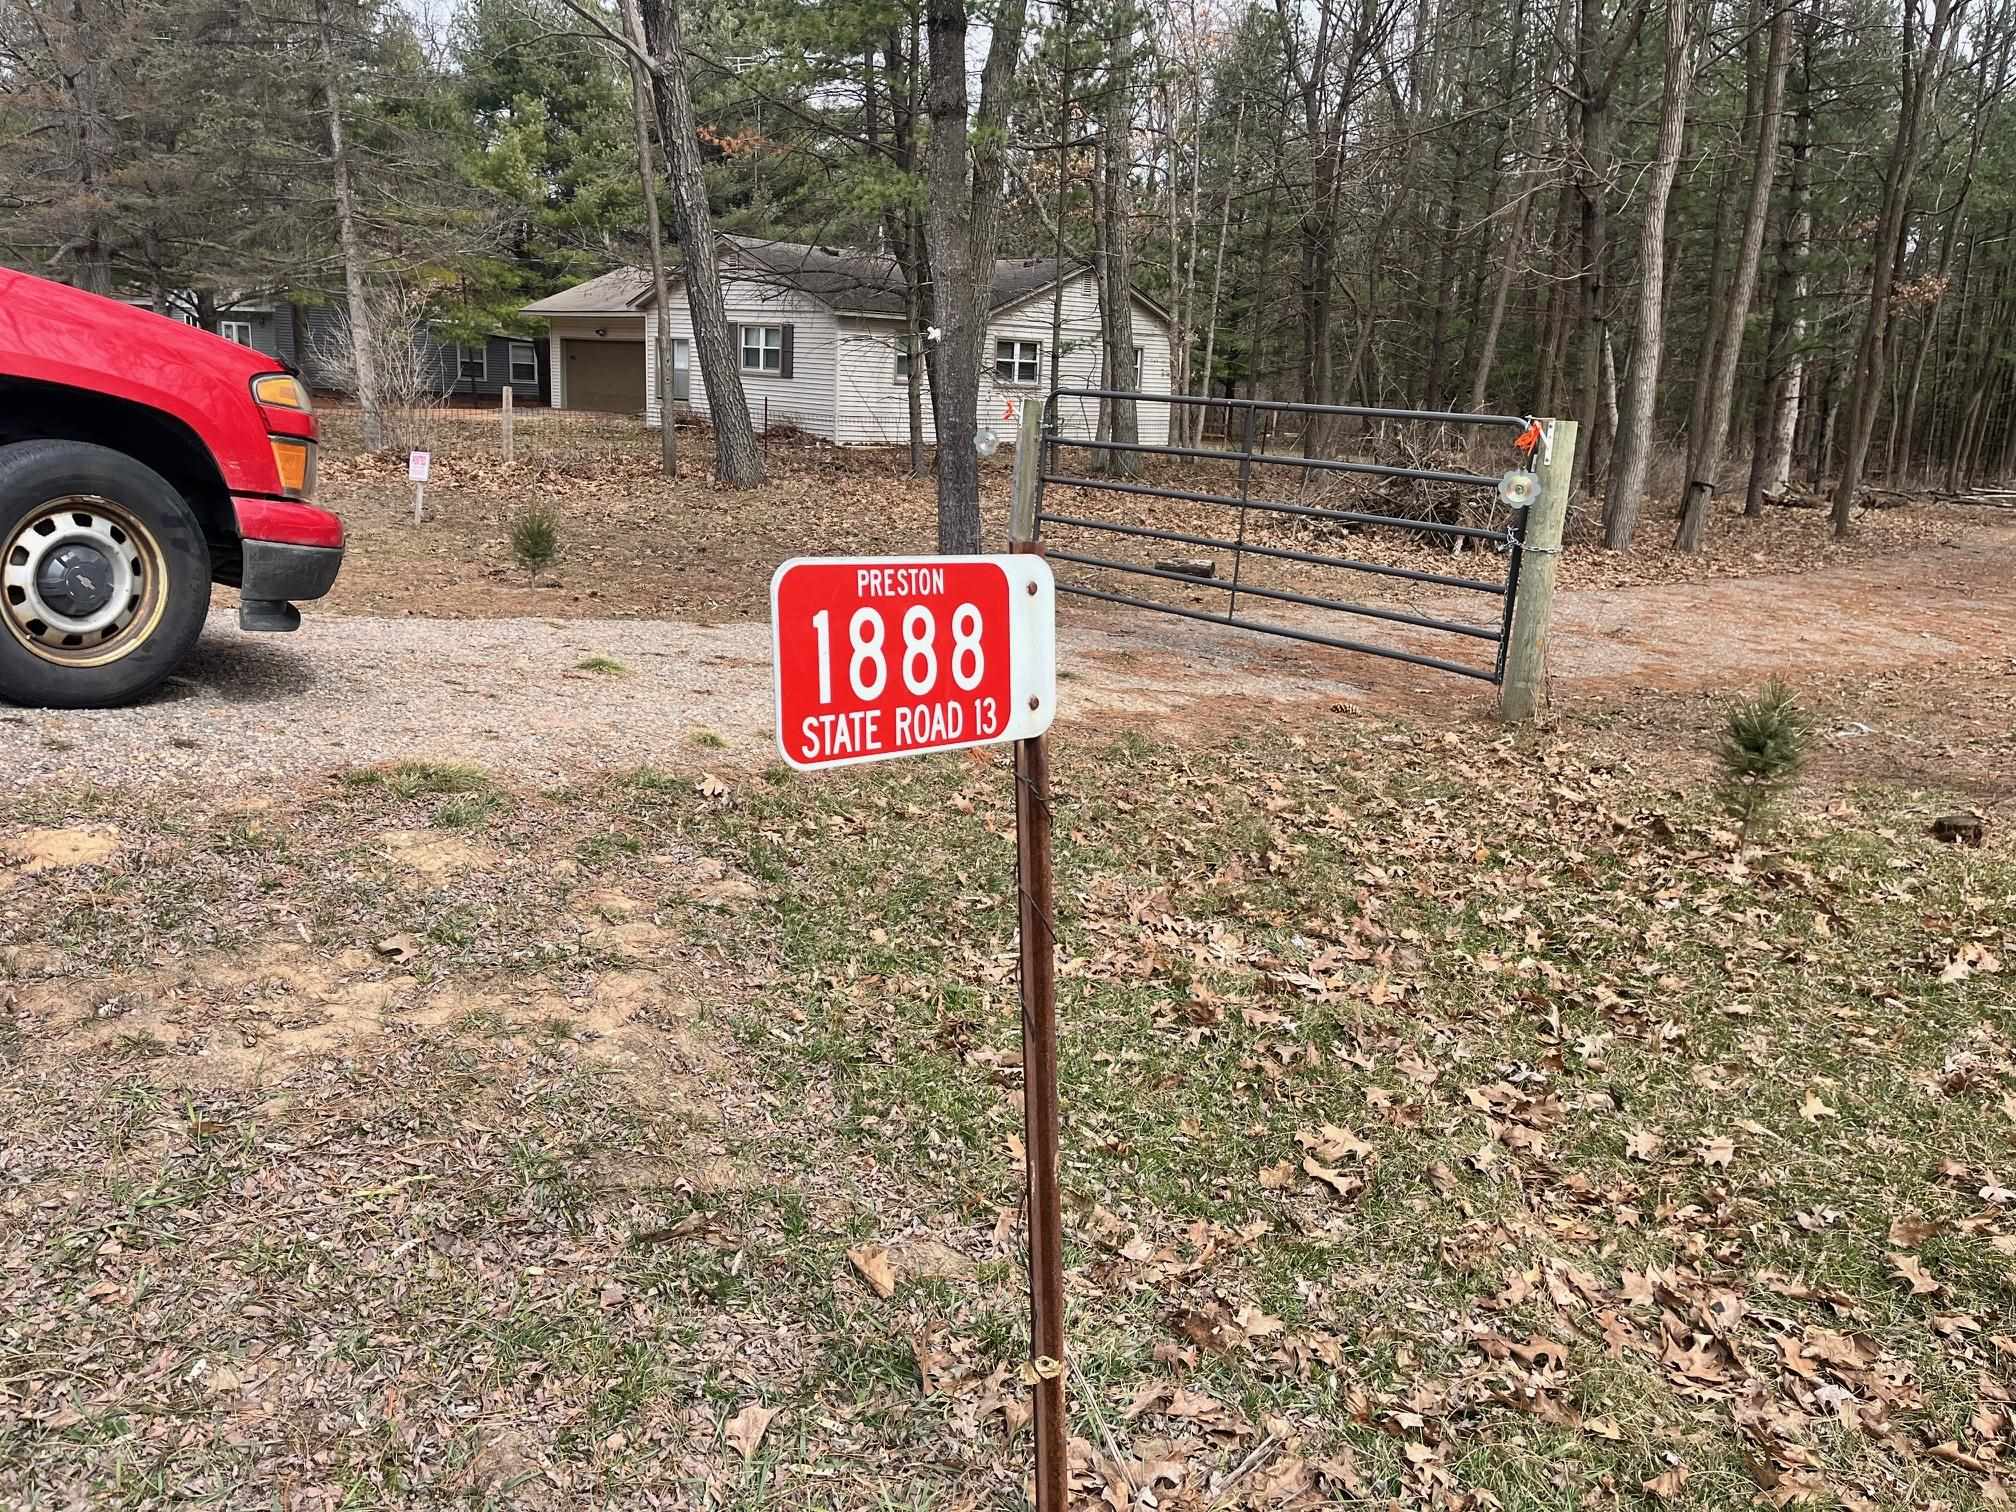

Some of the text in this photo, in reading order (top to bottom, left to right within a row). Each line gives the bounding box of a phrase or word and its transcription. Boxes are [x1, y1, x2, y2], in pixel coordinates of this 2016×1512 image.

[857, 568, 944, 597] PRESTON
[812, 603, 985, 704] 1888
[801, 697, 997, 758] STATE ROAD 13
